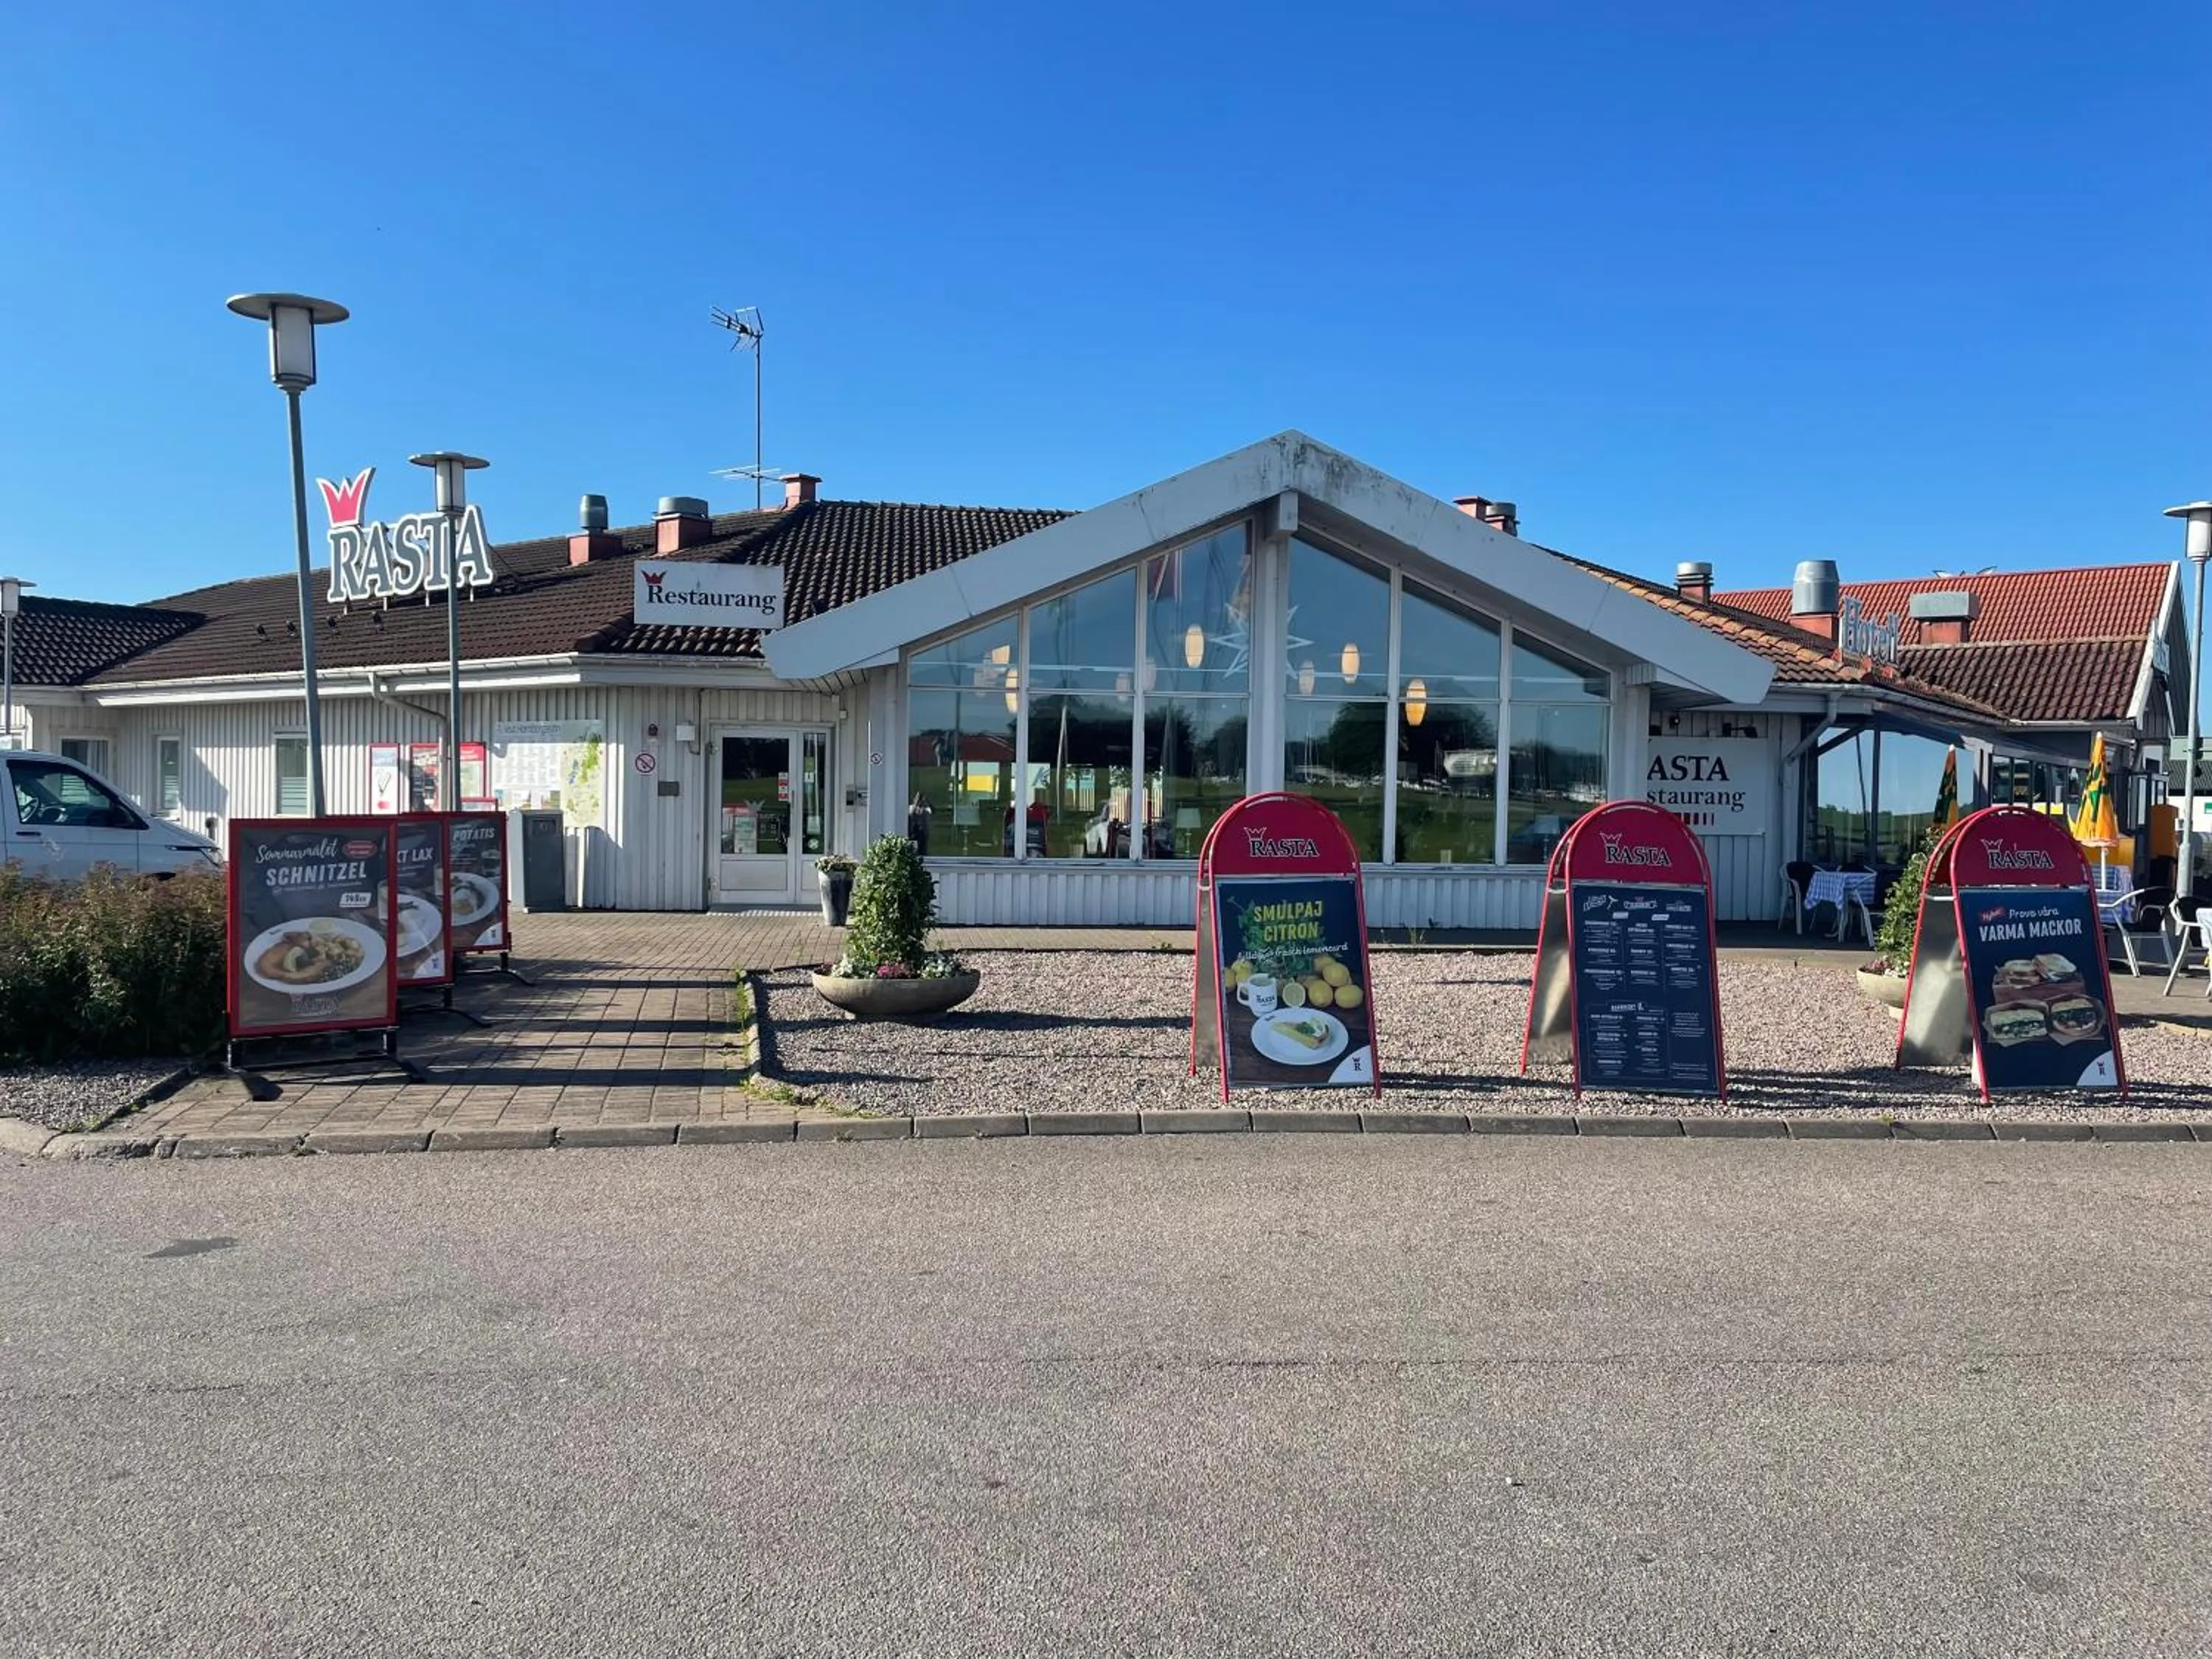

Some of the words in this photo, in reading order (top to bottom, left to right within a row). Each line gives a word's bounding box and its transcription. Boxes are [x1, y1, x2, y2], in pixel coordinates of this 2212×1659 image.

[327, 504, 493, 602] RASTA
[646, 584, 777, 616] Restaurang
[1646, 754, 1731, 782] ASTA
[1646, 787, 1747, 813] staurang
[411, 846, 434, 862] LAX
[1250, 838, 1321, 858] RASTA
[1604, 845, 1672, 867] RASTA
[1989, 849, 2056, 869] RASTA
[265, 860, 367, 886] SCHNITZEL
[1253, 900, 1322, 922] SMULPAJ
[2008, 908, 2037, 919] Prova
[2037, 905, 2059, 917] våra
[1263, 921, 1319, 942] CITRON
[1979, 922, 2026, 942] VARMA
[2028, 918, 2083, 939] MACKOR
